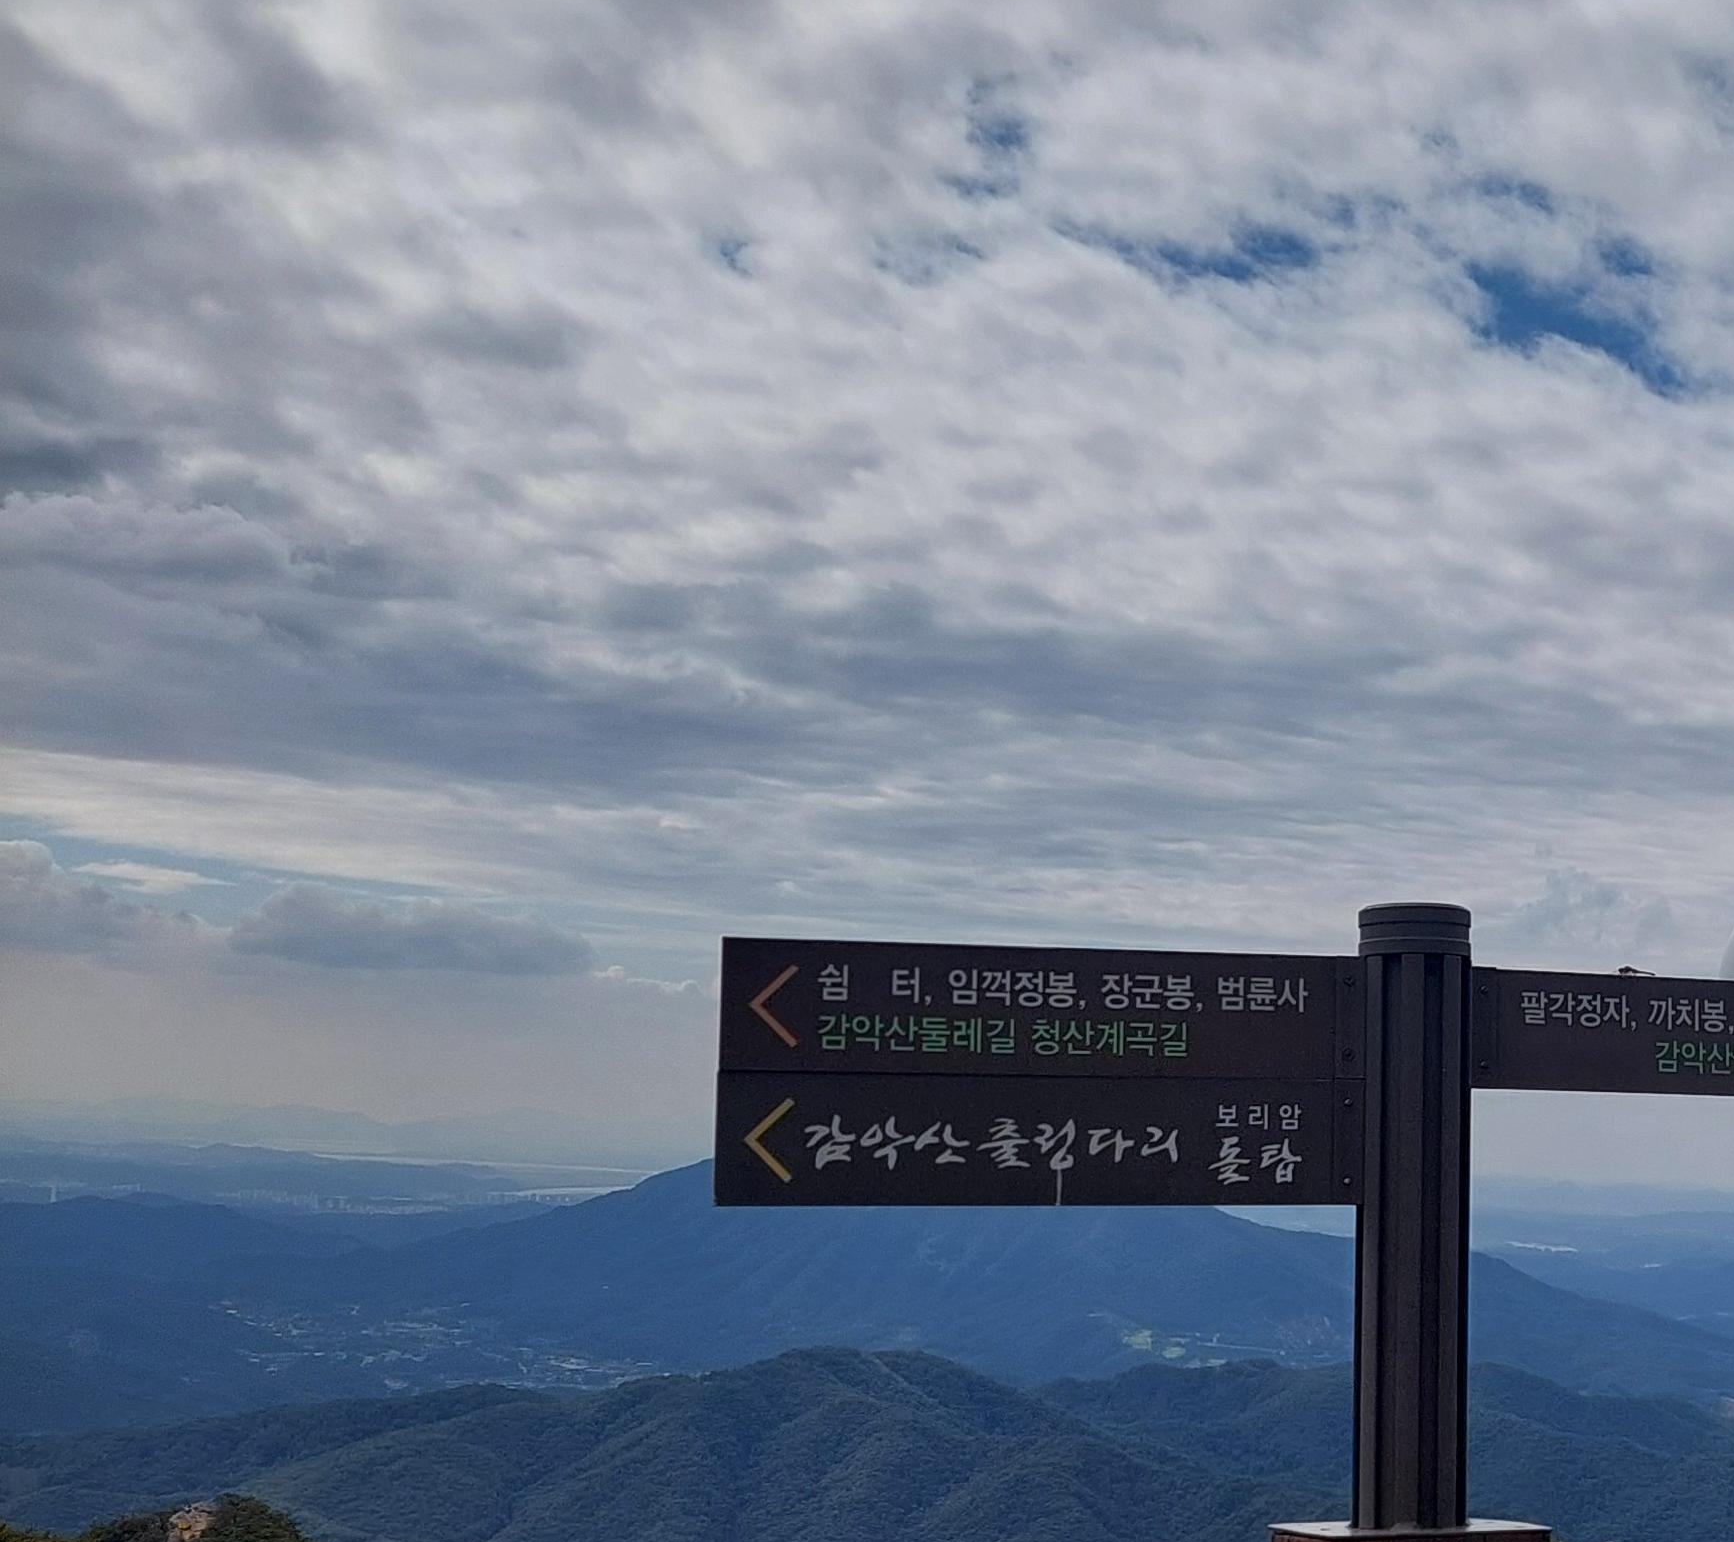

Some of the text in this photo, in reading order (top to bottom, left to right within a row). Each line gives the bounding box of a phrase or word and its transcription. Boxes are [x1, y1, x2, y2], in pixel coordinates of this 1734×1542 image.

[1101, 973, 1203, 1012] 장군봉,
[1217, 975, 1309, 1014] 범륜사
[1520, 991, 1637, 1032] 팔각정자,
[1647, 997, 1734, 1037] 까치봉,
[817, 1012, 1188, 1058] 감악산둘레길 청산계곡길
